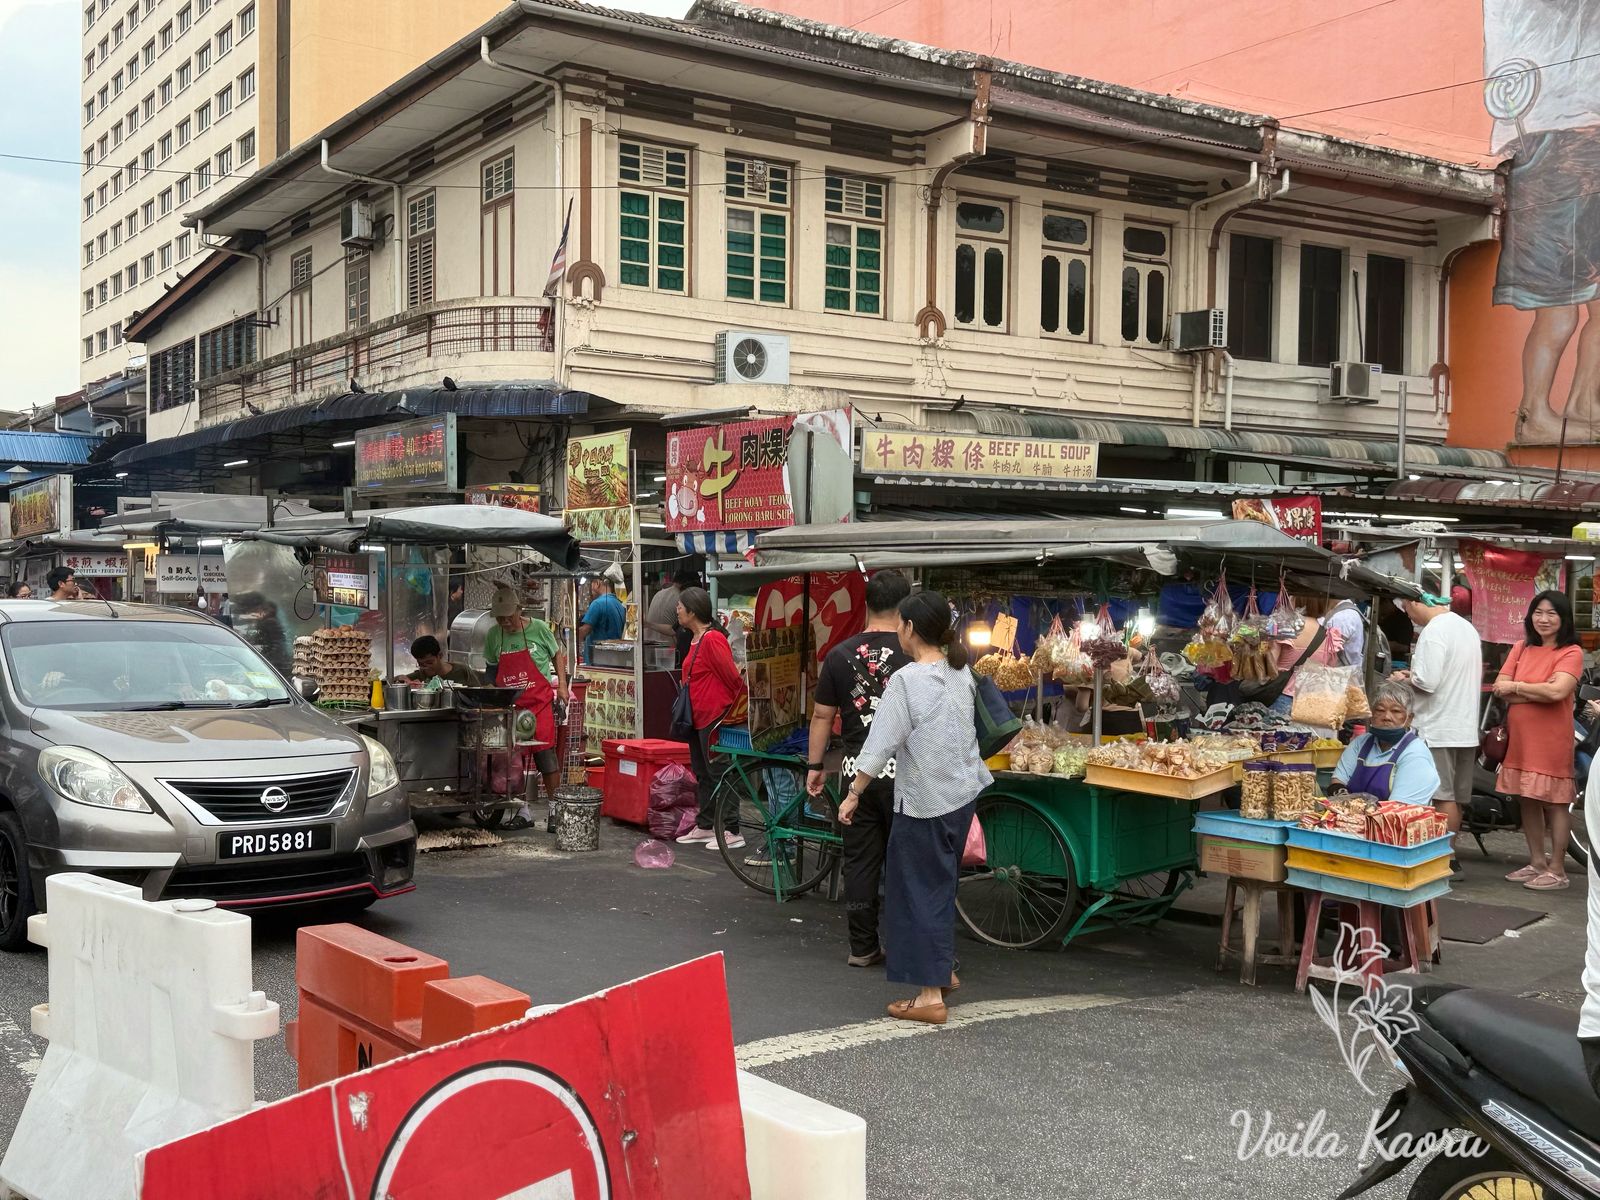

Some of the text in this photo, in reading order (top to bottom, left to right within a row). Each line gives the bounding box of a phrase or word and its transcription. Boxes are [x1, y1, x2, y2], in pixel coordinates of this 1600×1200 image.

[875, 434, 985, 471] 牛肉粿條
[989, 441, 1091, 461] BEEF BALL SOUP
[992, 459, 1022, 474] 牛肉丸
[725, 498, 743, 509] BEEF
[744, 496, 763, 508] KOAY
[725, 511, 753, 524] LORONG
[756, 510, 775, 522] BARU
[161, 574, 197, 582] Self-Service
[231, 830, 313, 855] PRD5881
